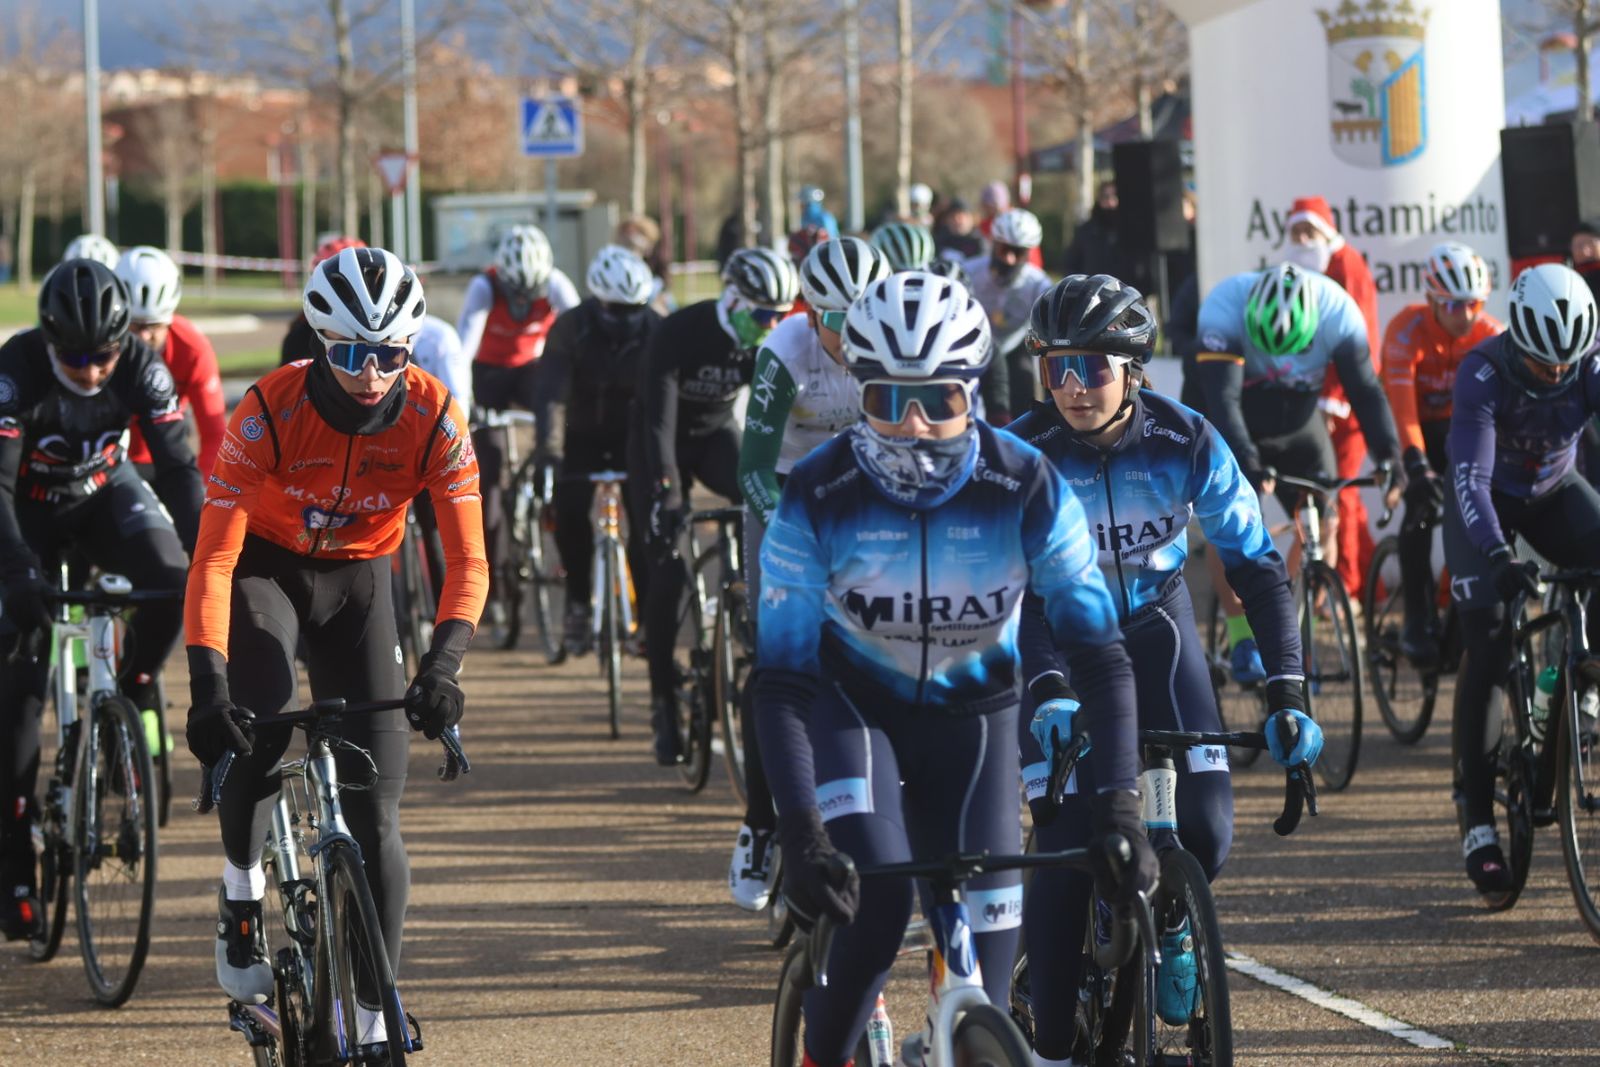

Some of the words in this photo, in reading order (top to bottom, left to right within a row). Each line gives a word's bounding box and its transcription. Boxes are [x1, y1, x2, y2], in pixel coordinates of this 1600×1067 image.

[1247, 194, 1498, 249] Ayntamiento
[1090, 514, 1176, 552] iRAT
[843, 586, 1009, 631] MiRAT
